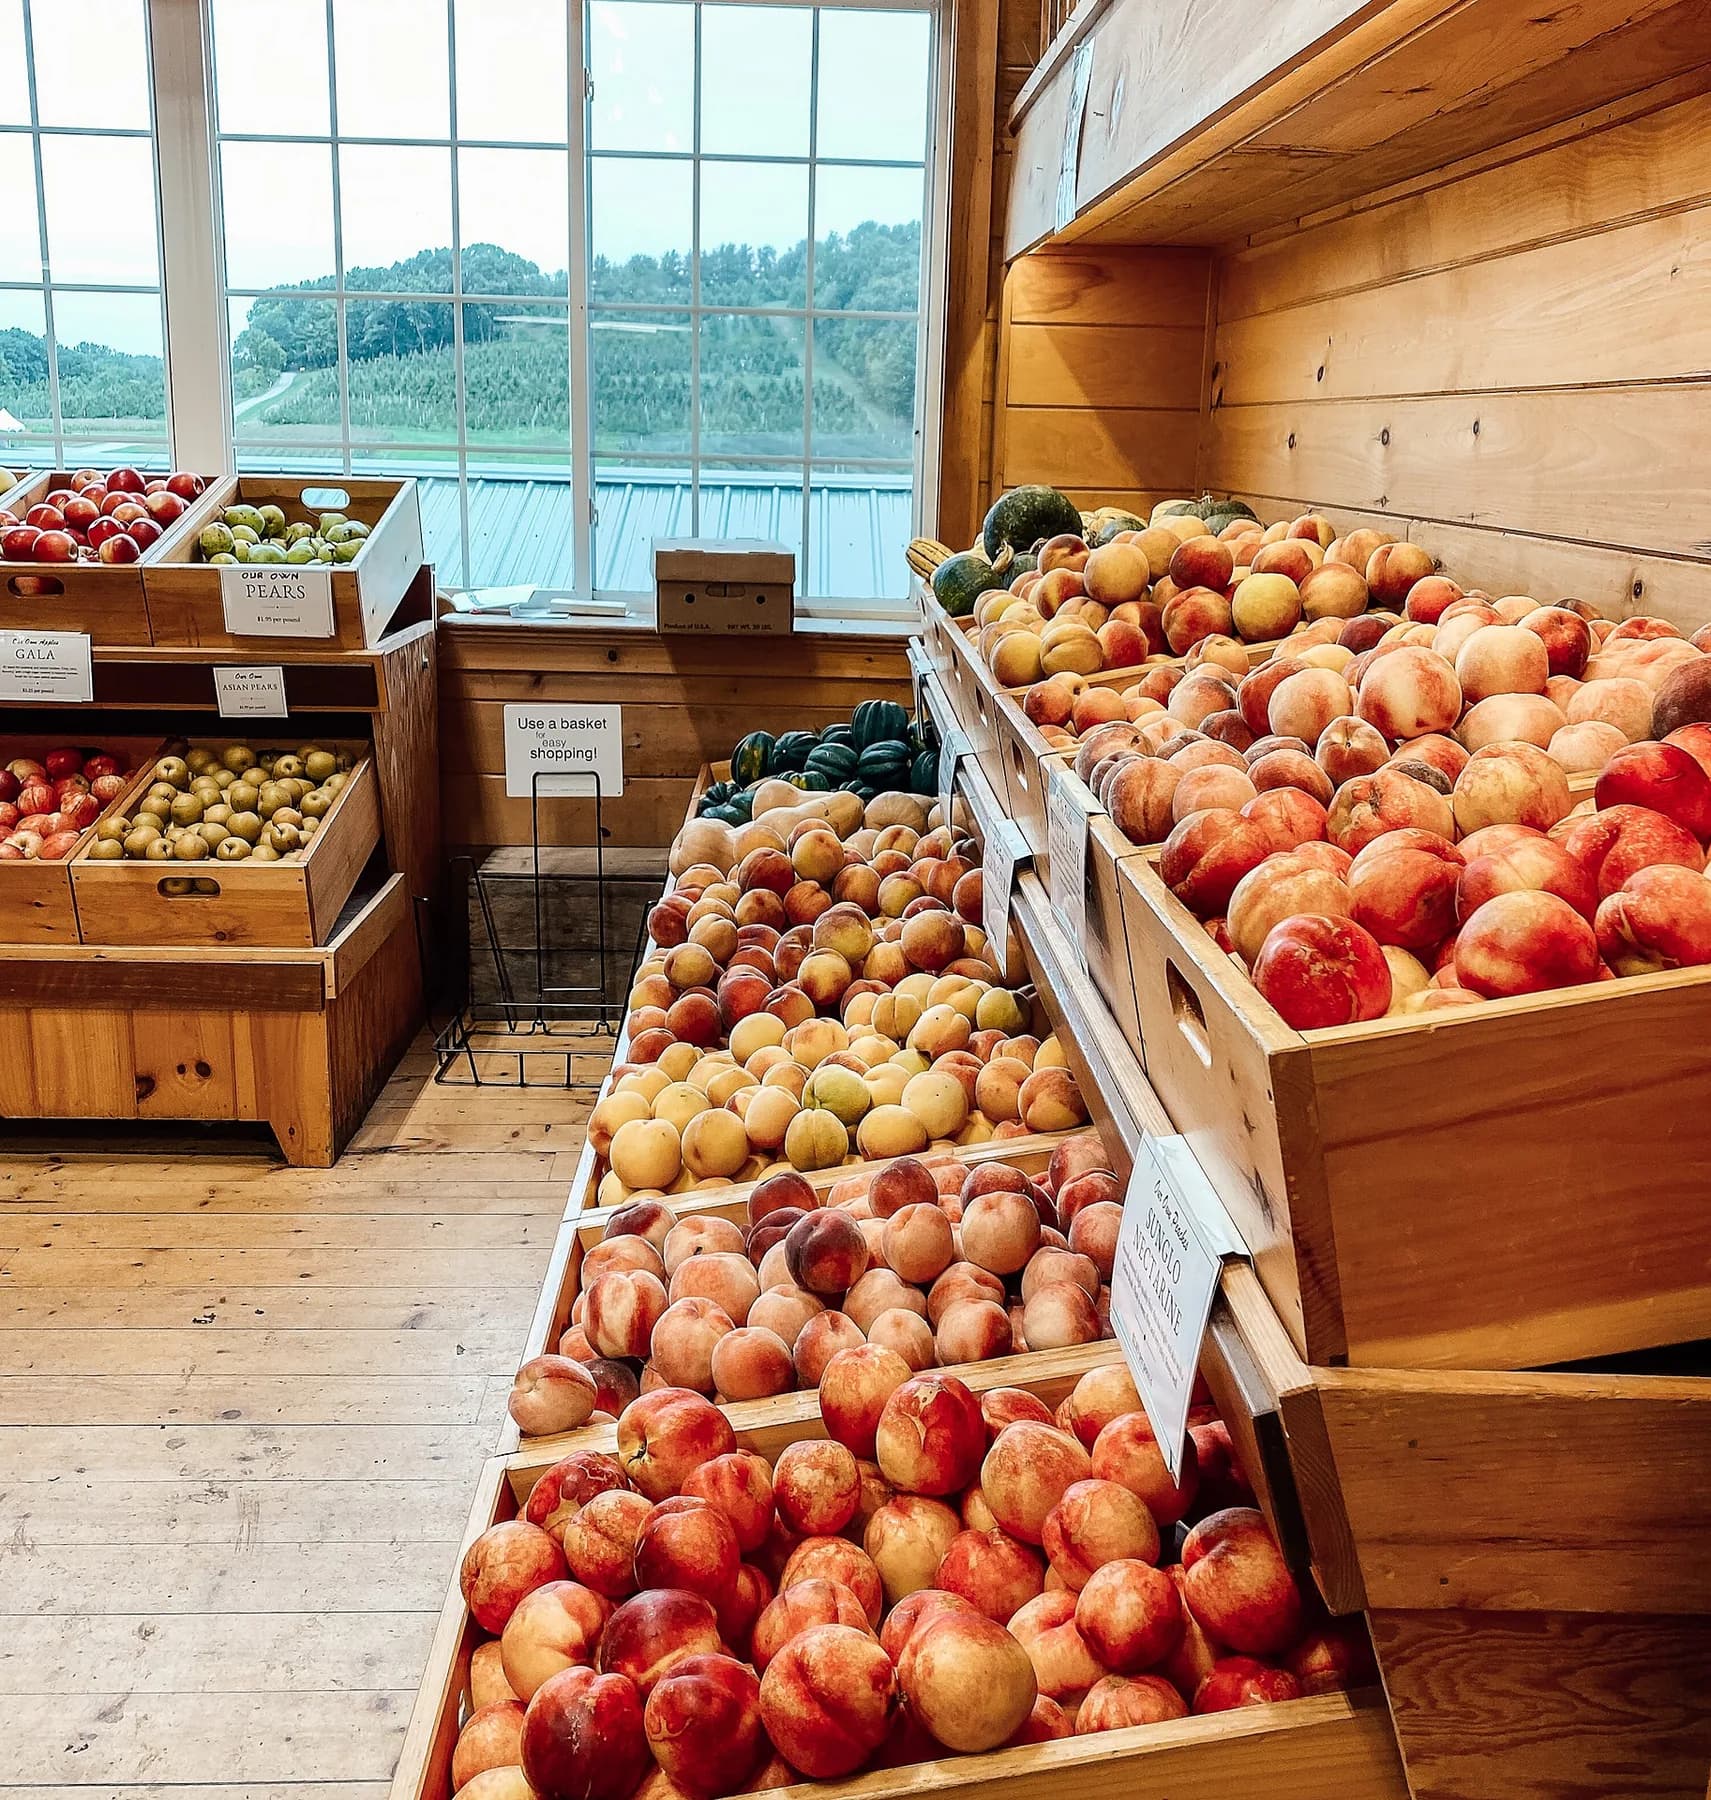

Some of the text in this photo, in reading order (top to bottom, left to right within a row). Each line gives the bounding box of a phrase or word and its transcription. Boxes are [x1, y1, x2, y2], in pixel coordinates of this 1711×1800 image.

[241, 572, 299, 581] OUR OWN
[246, 584, 306, 599] PEARS
[282, 616, 301, 625] pound
[15, 649, 55, 660] GALA
[518, 717, 607, 730] Use a basket
[536, 731, 546, 739] for
[542, 739, 567, 748] easy
[530, 747, 597, 762] shopping!
[1146, 1207, 1181, 1285] SUNGLO
[1133, 1223, 1183, 1335] NECTARINE
